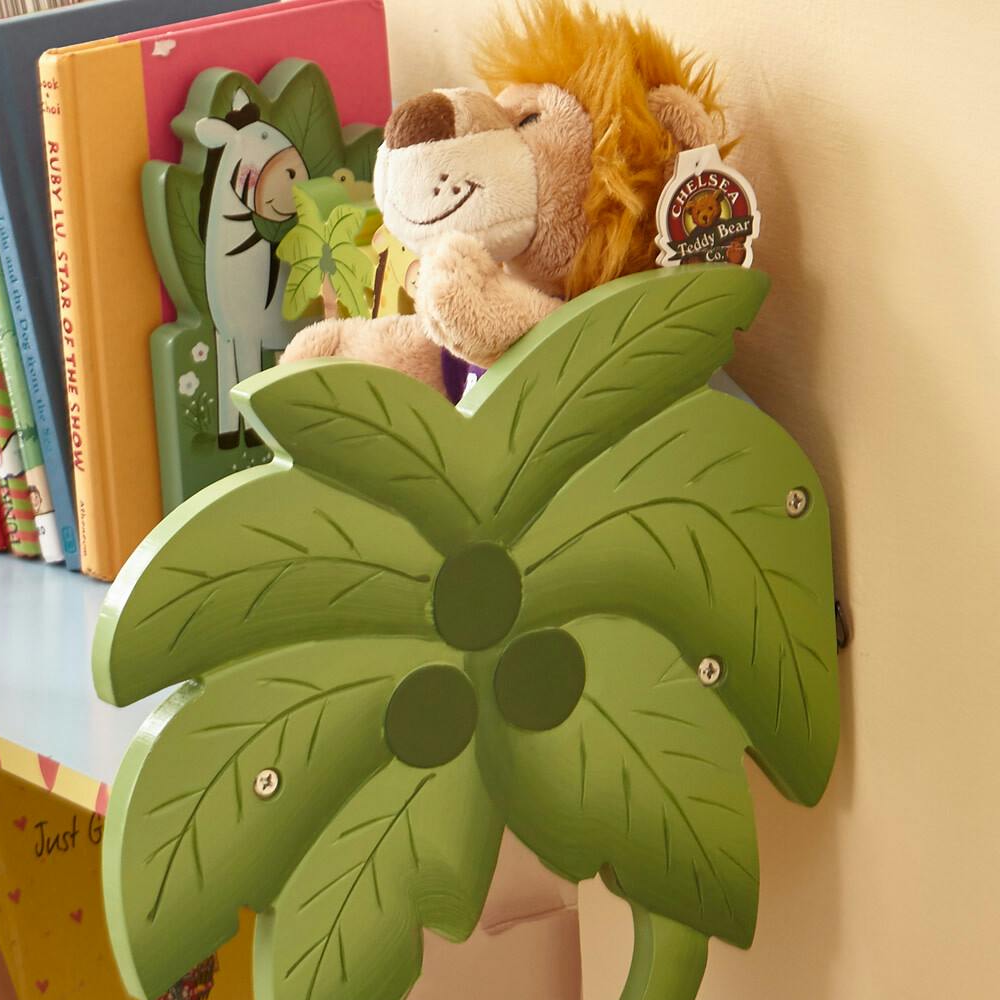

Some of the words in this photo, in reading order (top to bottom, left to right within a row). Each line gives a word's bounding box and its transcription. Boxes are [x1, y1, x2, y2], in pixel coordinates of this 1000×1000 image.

[47, 139, 64, 202] RUBY
[672, 173, 740, 218] CHELSEA
[677, 232, 715, 257] Teddy
[717, 220, 751, 239] Bear
[705, 250, 725, 262] Co.
[3, 255, 20, 290] and
[56, 250, 72, 309] STAR
[13, 294, 26, 313] the
[15, 317, 35, 351] Dog
[61, 316, 75, 348] OF
[24, 355, 44, 394] from
[64, 353, 79, 396] THE
[68, 403, 86, 473] SHOW
[34, 820, 79, 858] Just
[89, 814, 105, 845] G
